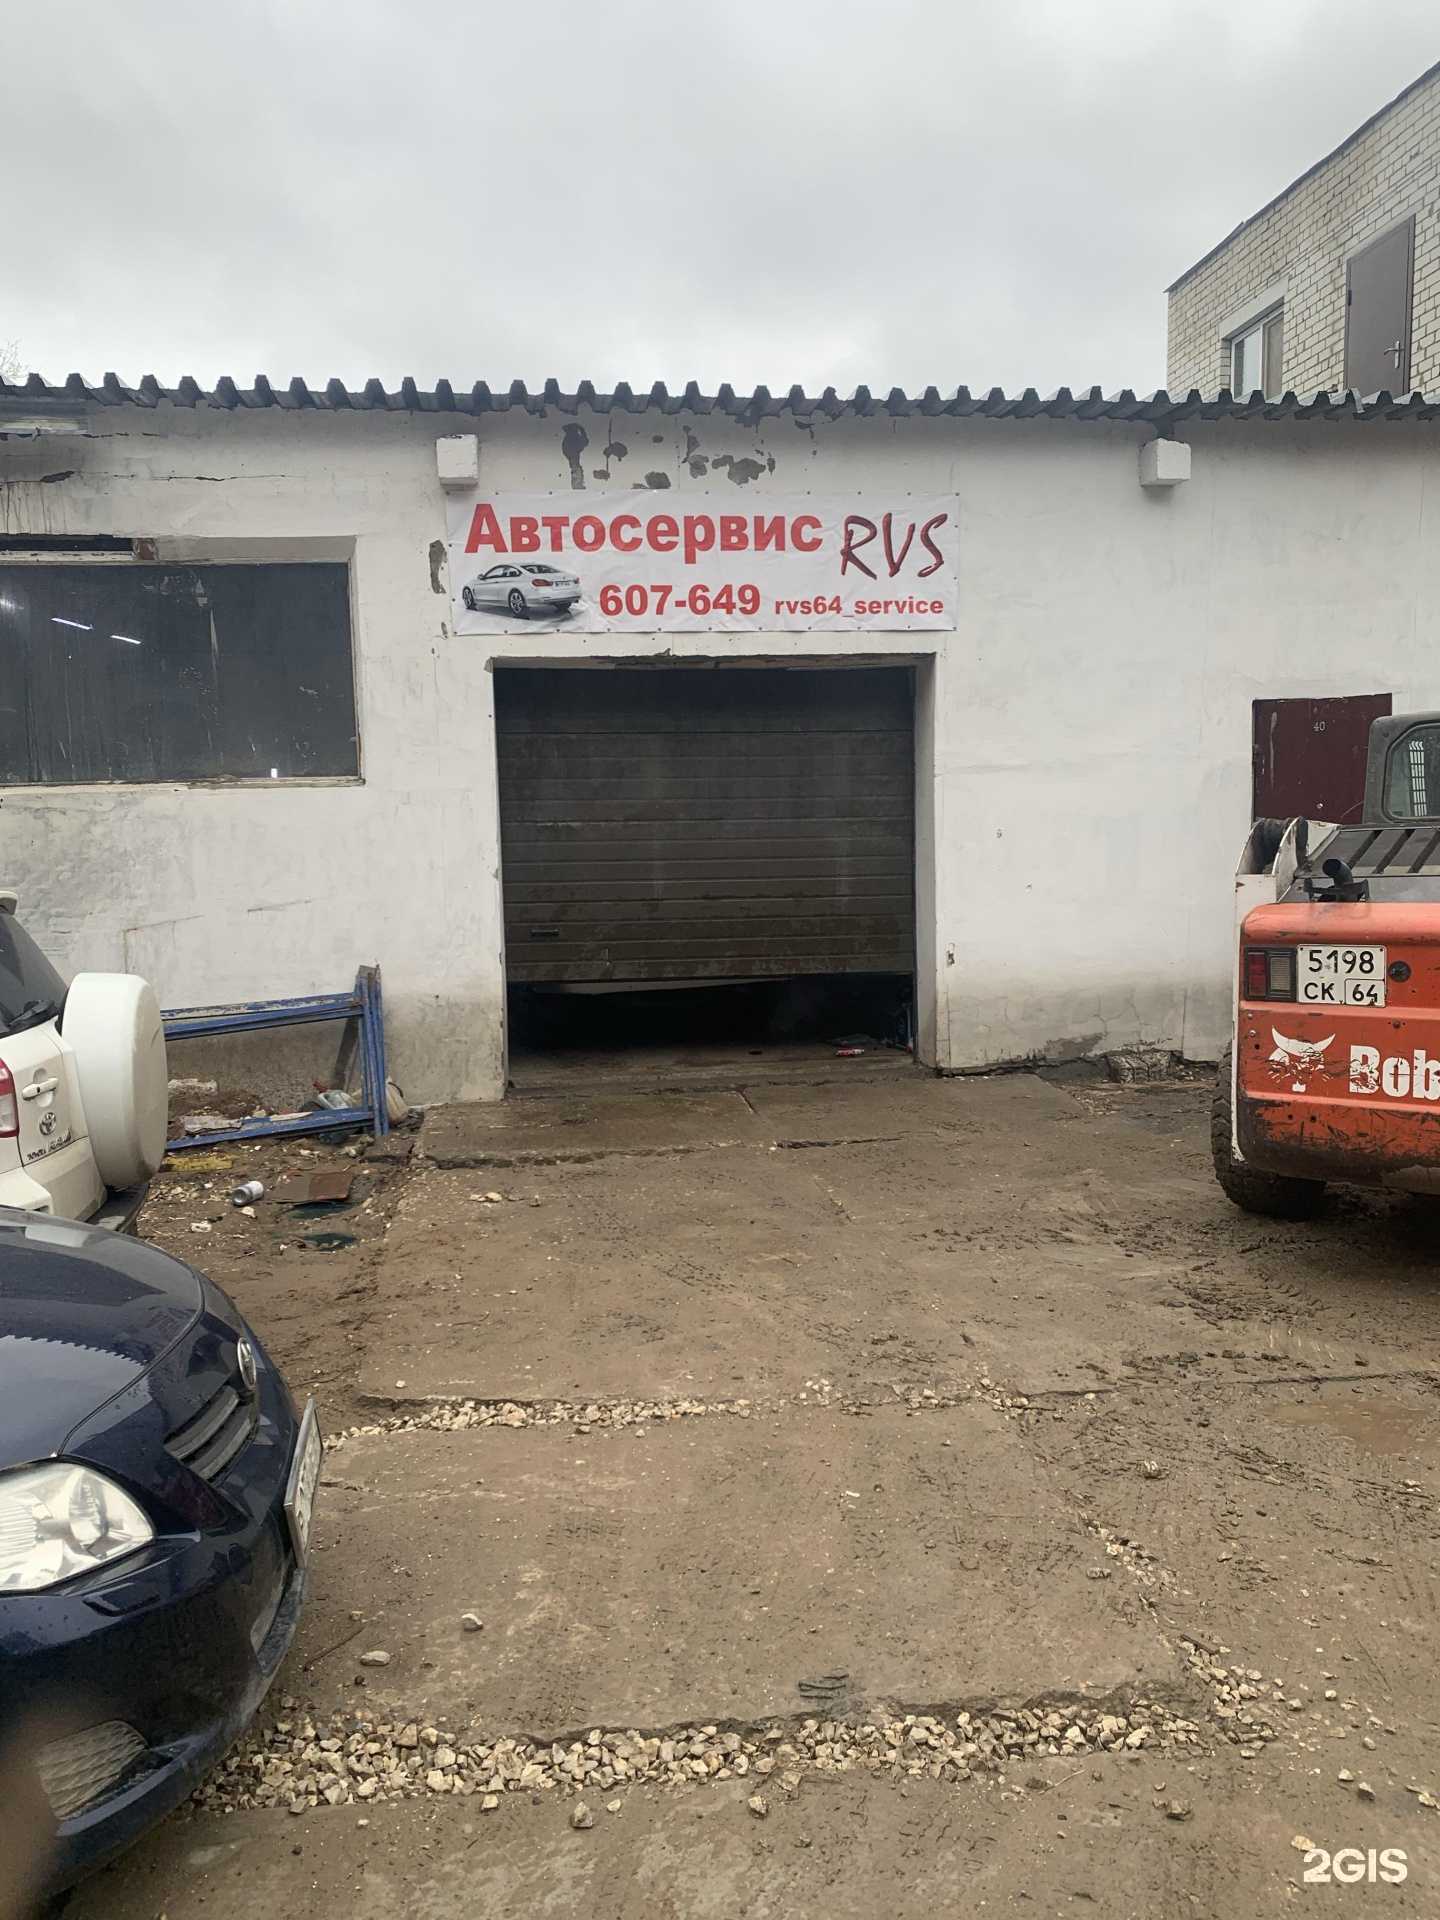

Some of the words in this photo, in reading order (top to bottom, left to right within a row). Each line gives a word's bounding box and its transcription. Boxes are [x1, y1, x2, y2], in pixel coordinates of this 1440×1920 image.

[464, 503, 823, 564] Автосервис
[840, 512, 948, 580] RVS
[600, 584, 760, 616] 607-649
[775, 595, 944, 618] rvs64_service
[1313, 721, 1326, 732] 40
[1308, 949, 1375, 975] 5198
[1304, 982, 1335, 1001] СК
[1352, 983, 1378, 1003] 64
